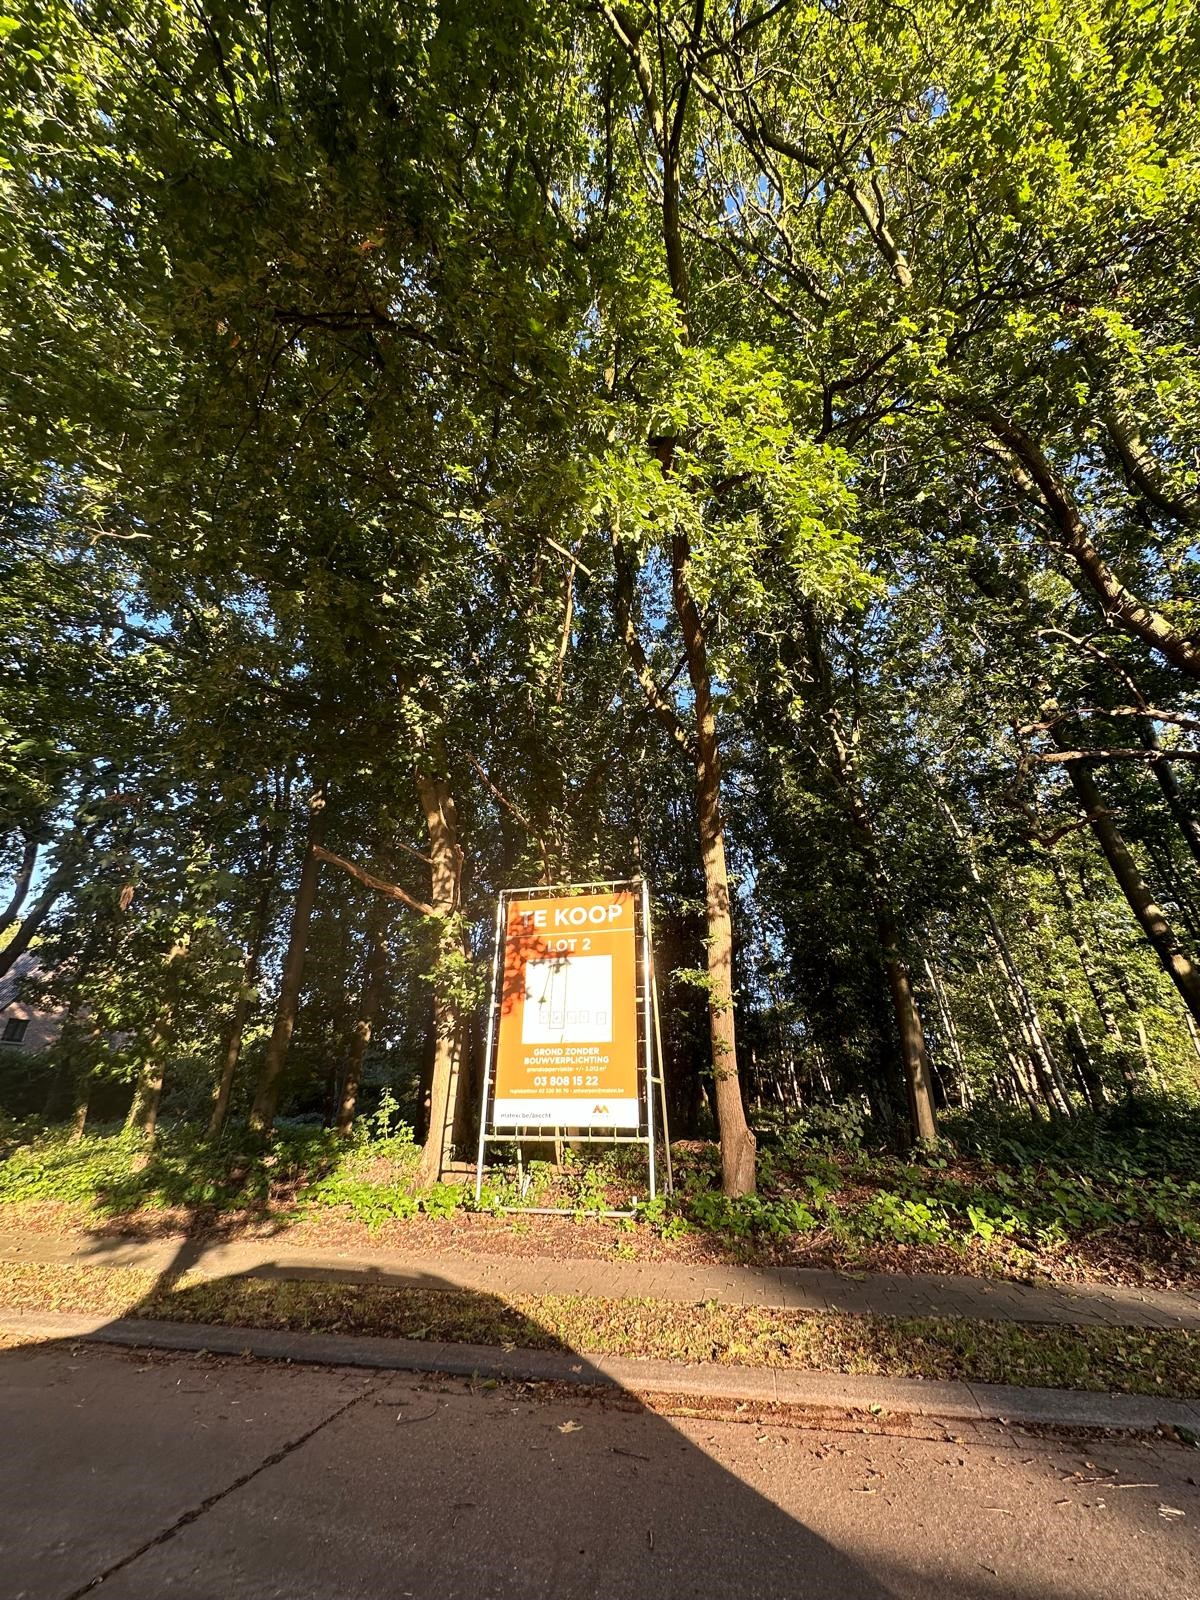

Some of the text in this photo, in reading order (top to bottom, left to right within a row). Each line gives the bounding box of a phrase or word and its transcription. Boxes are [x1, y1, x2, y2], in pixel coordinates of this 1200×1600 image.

[519, 905, 623, 928] TE KOOP
[547, 938, 591, 952] LOT 2
[534, 1047, 599, 1056] GROND ZONDER
[524, 1056, 609, 1064] BOUWVERPLICHTING
[534, 1076, 546, 1085] 03
[573, 1076, 582, 1085] 15
[585, 1075, 598, 1085] 22
